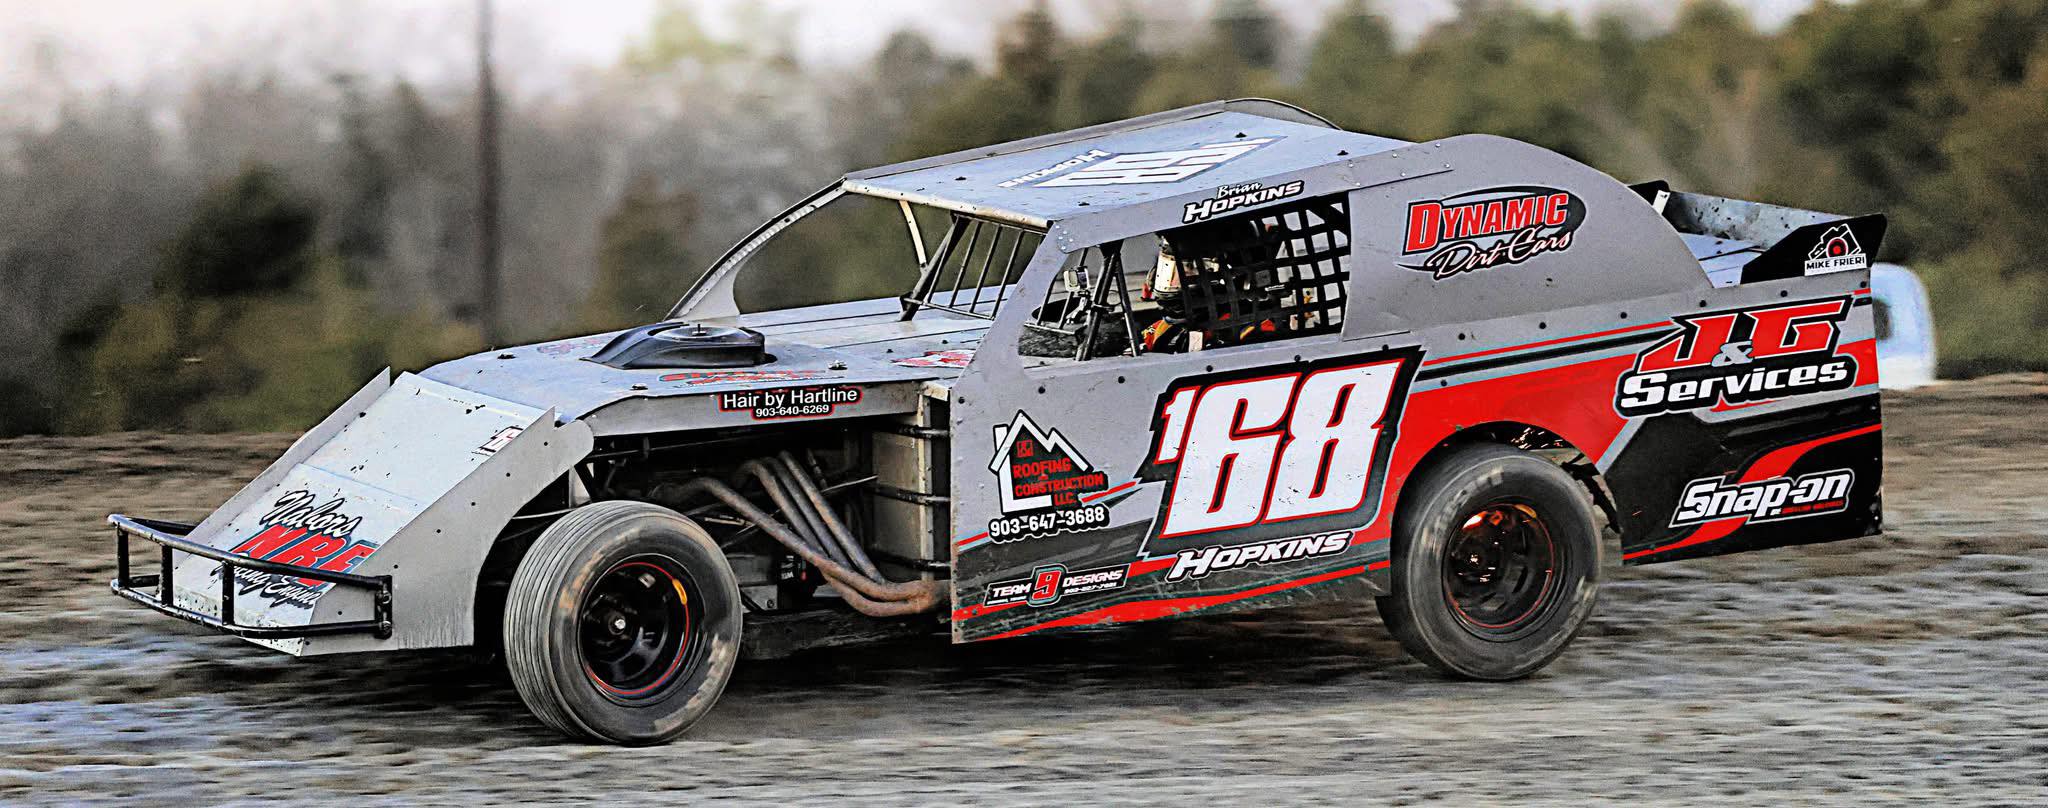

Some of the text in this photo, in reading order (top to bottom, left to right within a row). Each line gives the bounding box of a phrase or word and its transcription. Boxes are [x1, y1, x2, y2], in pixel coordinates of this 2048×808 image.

[1183, 182, 1303, 222] HOPKINS
[1217, 182, 1262, 198] Brian
[1405, 193, 1569, 252] DYNAMIC
[1427, 225, 1572, 277] Dirt Cars
[1807, 260, 1830, 270] MIKE
[723, 388, 857, 408] Hair by Hartline
[1620, 361, 1848, 408] Services
[755, 404, 829, 417] 903-640-6269
[1155, 358, 1406, 537] 168
[1012, 457, 1072, 478] ROOFING
[1015, 473, 1104, 497] CONSTRUCTION
[1676, 473, 1850, 521] Snap-on
[990, 506, 1105, 537] 903-647-3688
[1168, 532, 1350, 579] HOPKINS
[993, 583, 1032, 597] TEAM
[1032, 571, 1061, 600] 9
[1063, 569, 1123, 587] DESIGNS
